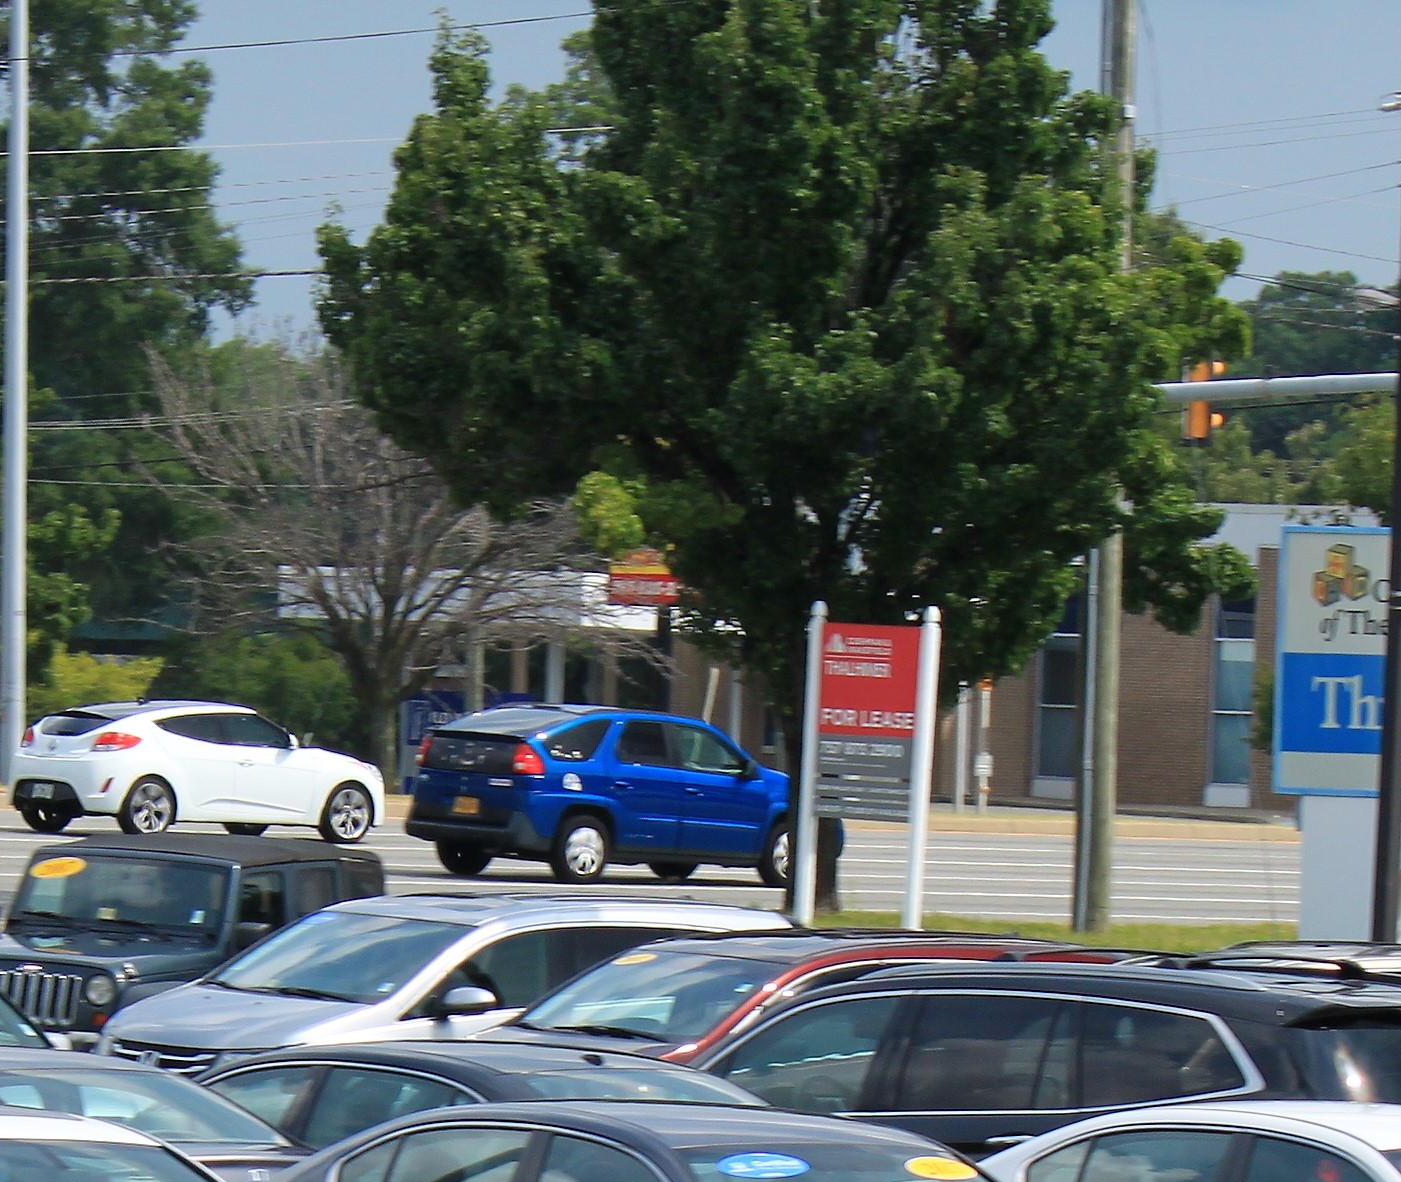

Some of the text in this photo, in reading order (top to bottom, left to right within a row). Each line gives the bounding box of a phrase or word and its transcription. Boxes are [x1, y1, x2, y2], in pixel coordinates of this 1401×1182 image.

[1319, 609, 1341, 642] of
[820, 707, 915, 730] FOR LEASE
